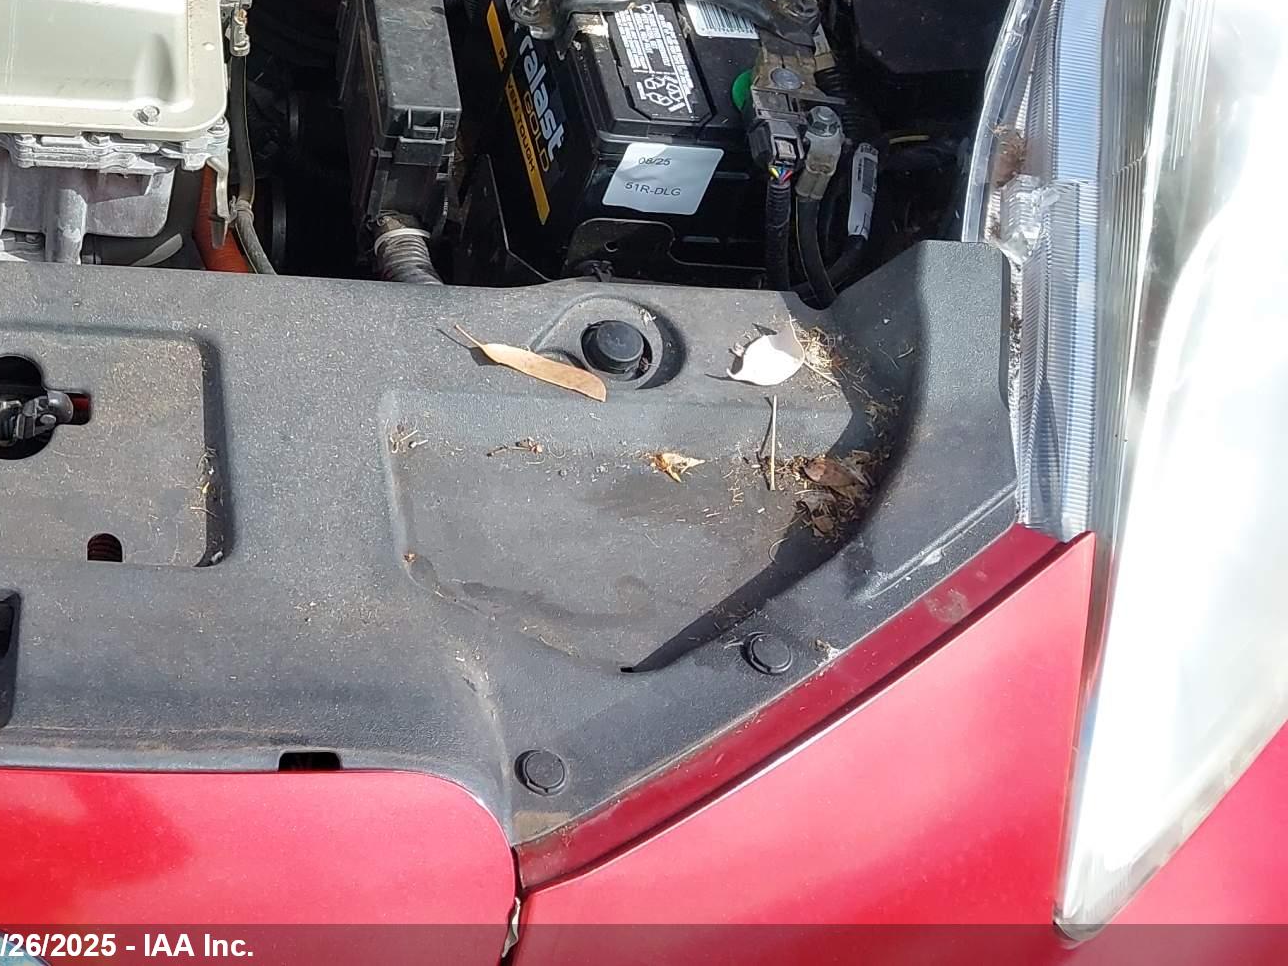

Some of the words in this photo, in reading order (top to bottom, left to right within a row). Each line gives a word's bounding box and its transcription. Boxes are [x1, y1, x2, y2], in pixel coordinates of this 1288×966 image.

[499, 49, 521, 112] PVEN
[516, 113, 536, 172] TOUGH
[523, 91, 551, 172] GOLD
[638, 156, 672, 167] 08/25
[624, 181, 682, 196] 51R-DLG
